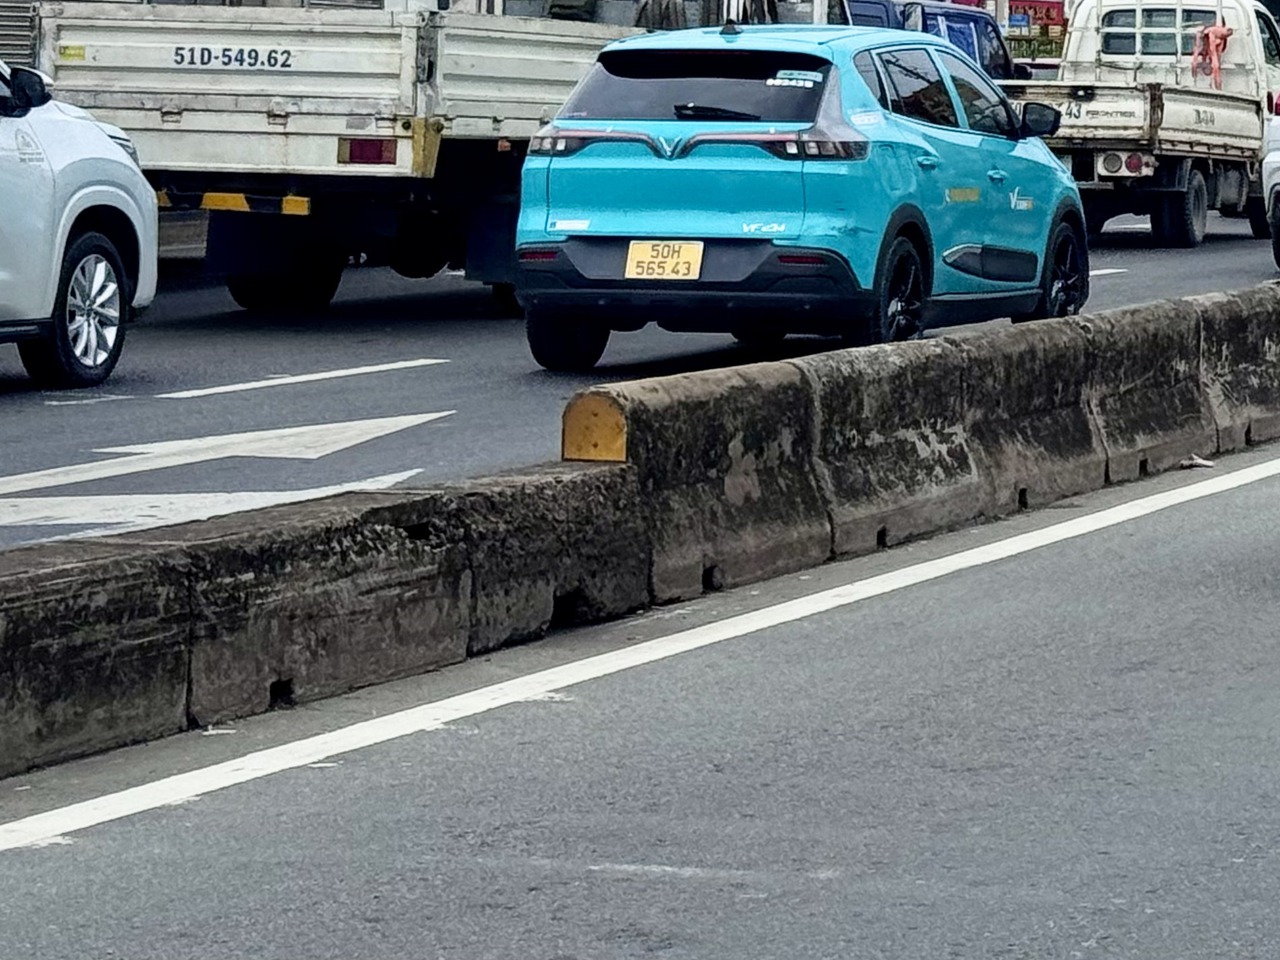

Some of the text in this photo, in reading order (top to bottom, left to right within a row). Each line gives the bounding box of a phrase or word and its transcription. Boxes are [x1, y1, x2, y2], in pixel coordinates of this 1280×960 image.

[173, 46, 292, 68] 51D-549.62
[650, 244, 683, 259] 50H
[635, 261, 692, 277] 565.43
